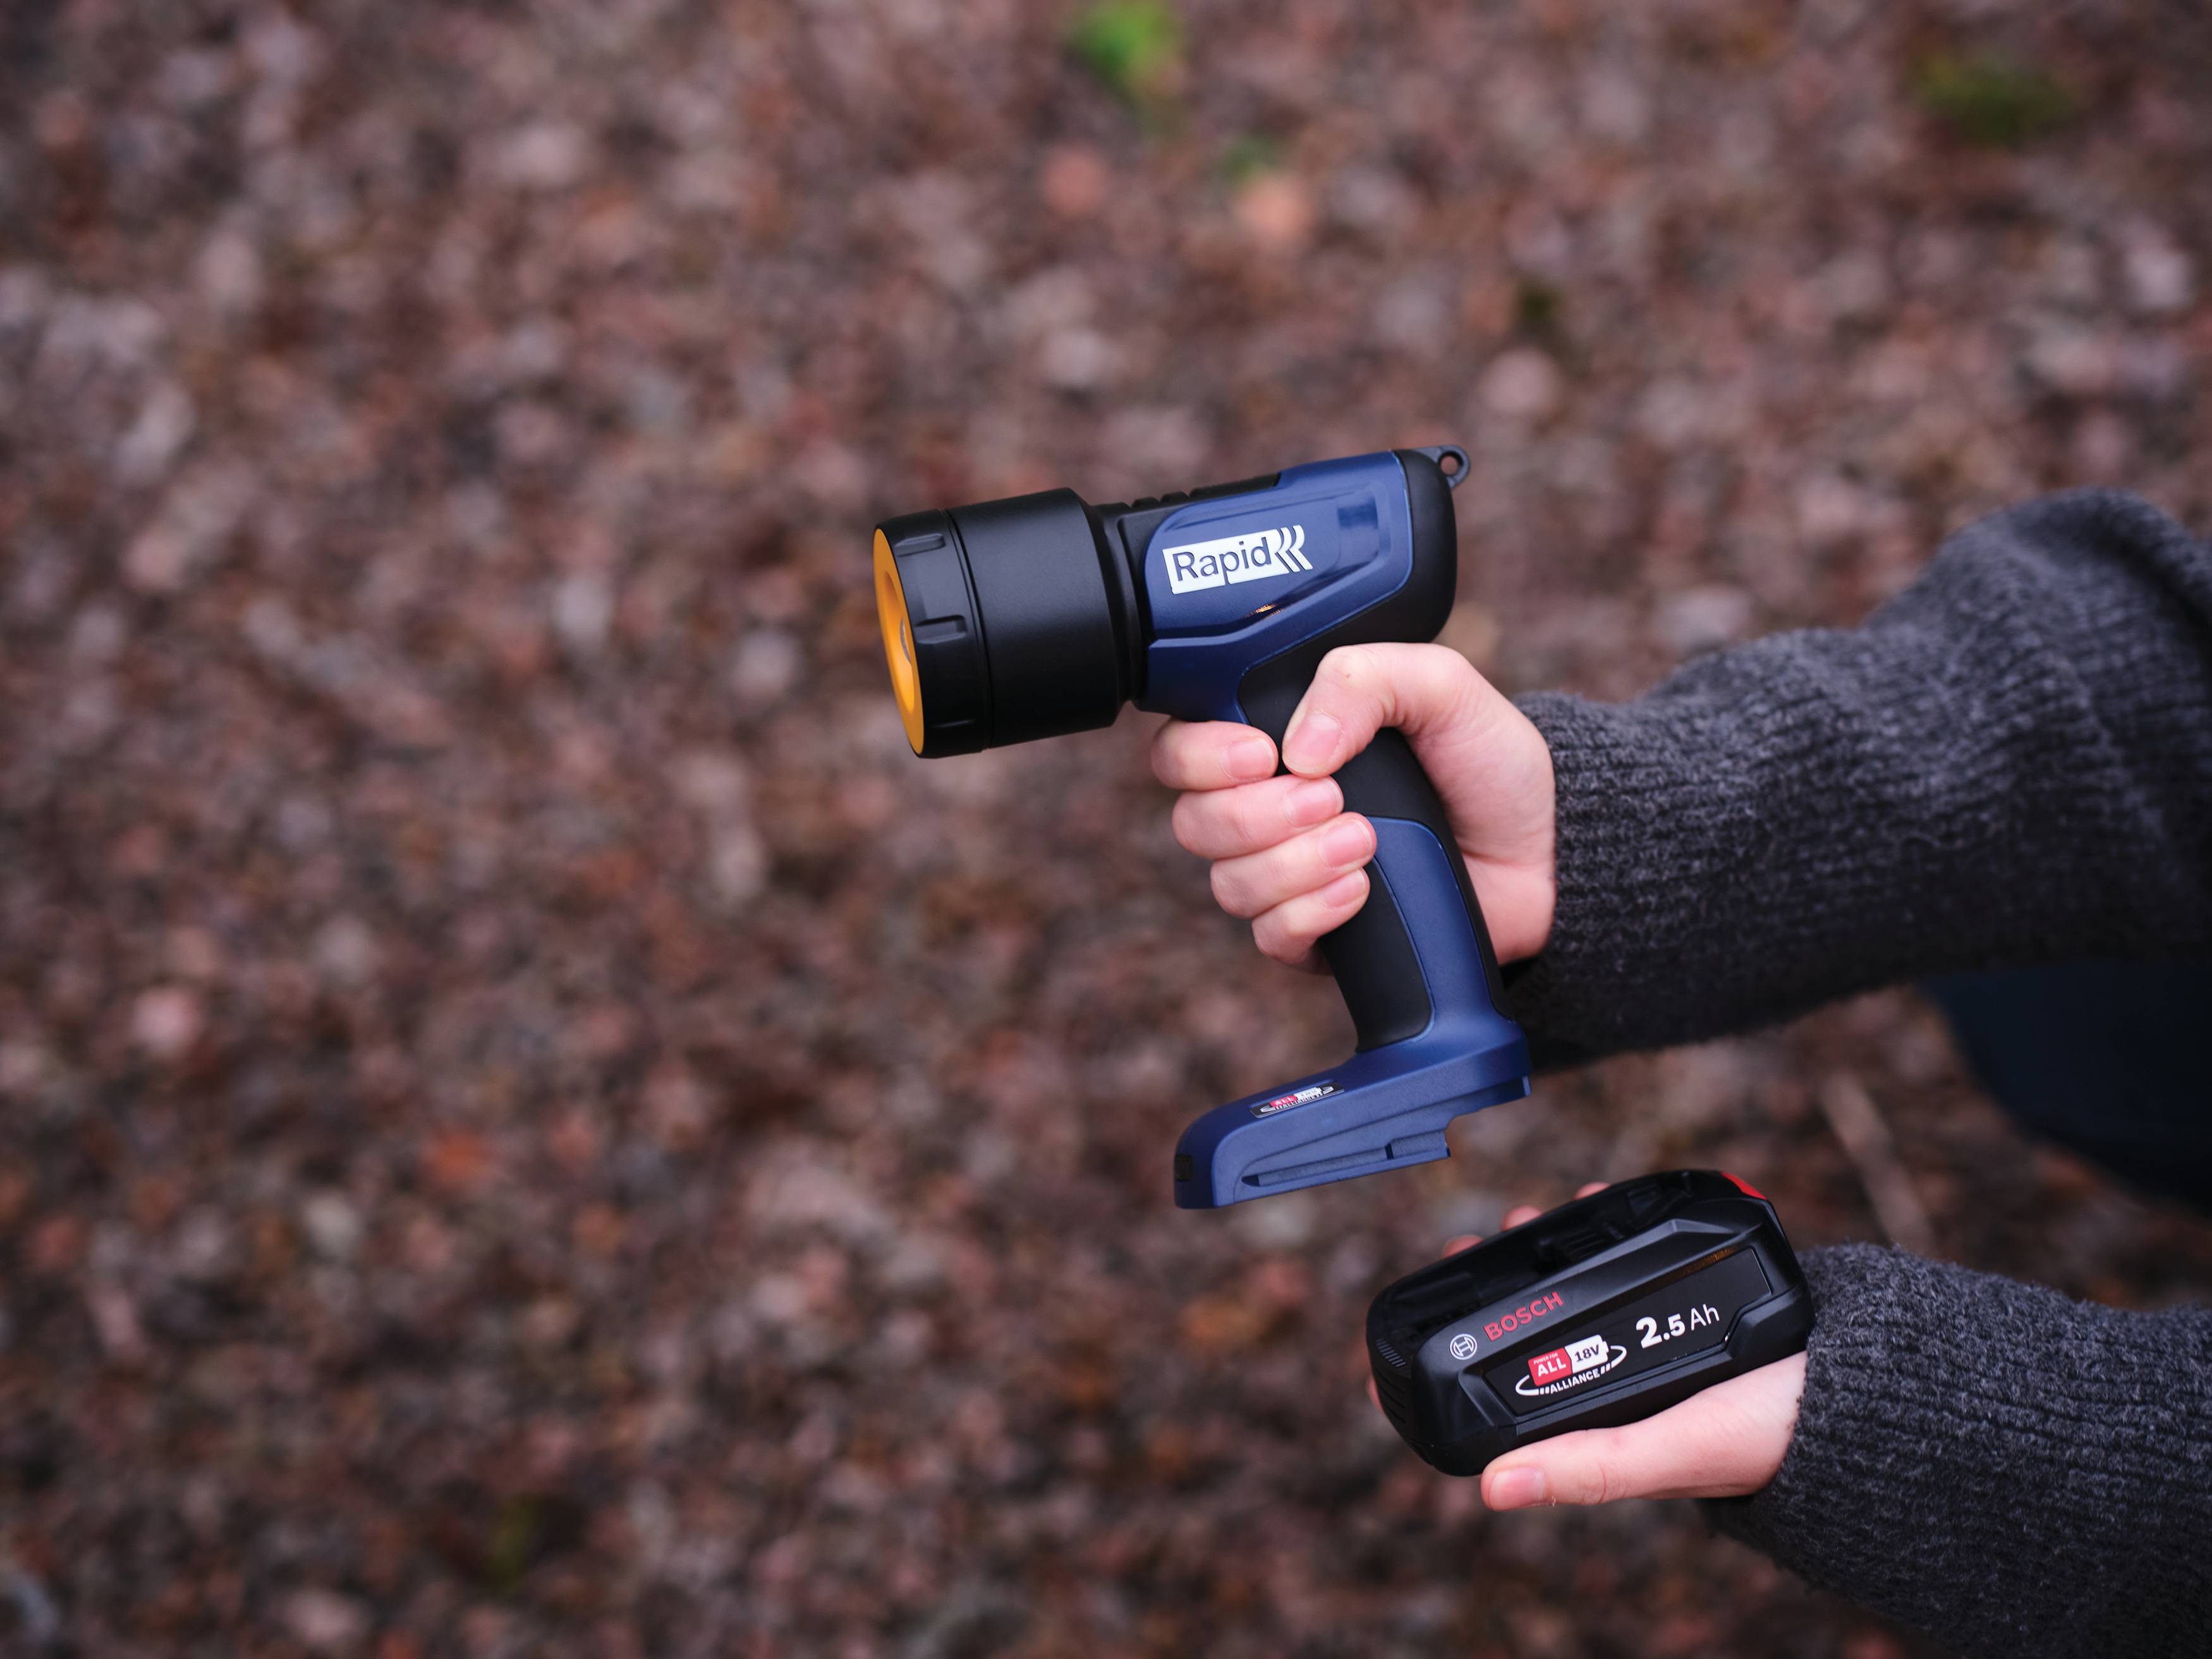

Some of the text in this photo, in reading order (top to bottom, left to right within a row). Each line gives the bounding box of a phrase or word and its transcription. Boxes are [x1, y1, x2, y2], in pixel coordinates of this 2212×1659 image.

[1172, 537, 1272, 585] Rapid
[1483, 1291, 1564, 1342] BOSCH
[1636, 1304, 1720, 1349] 2.5 Ah
[1538, 1358, 1567, 1377] ALL
[1574, 1345, 1600, 1363] 18V
[1550, 1368, 1600, 1394] ALLIANCE
